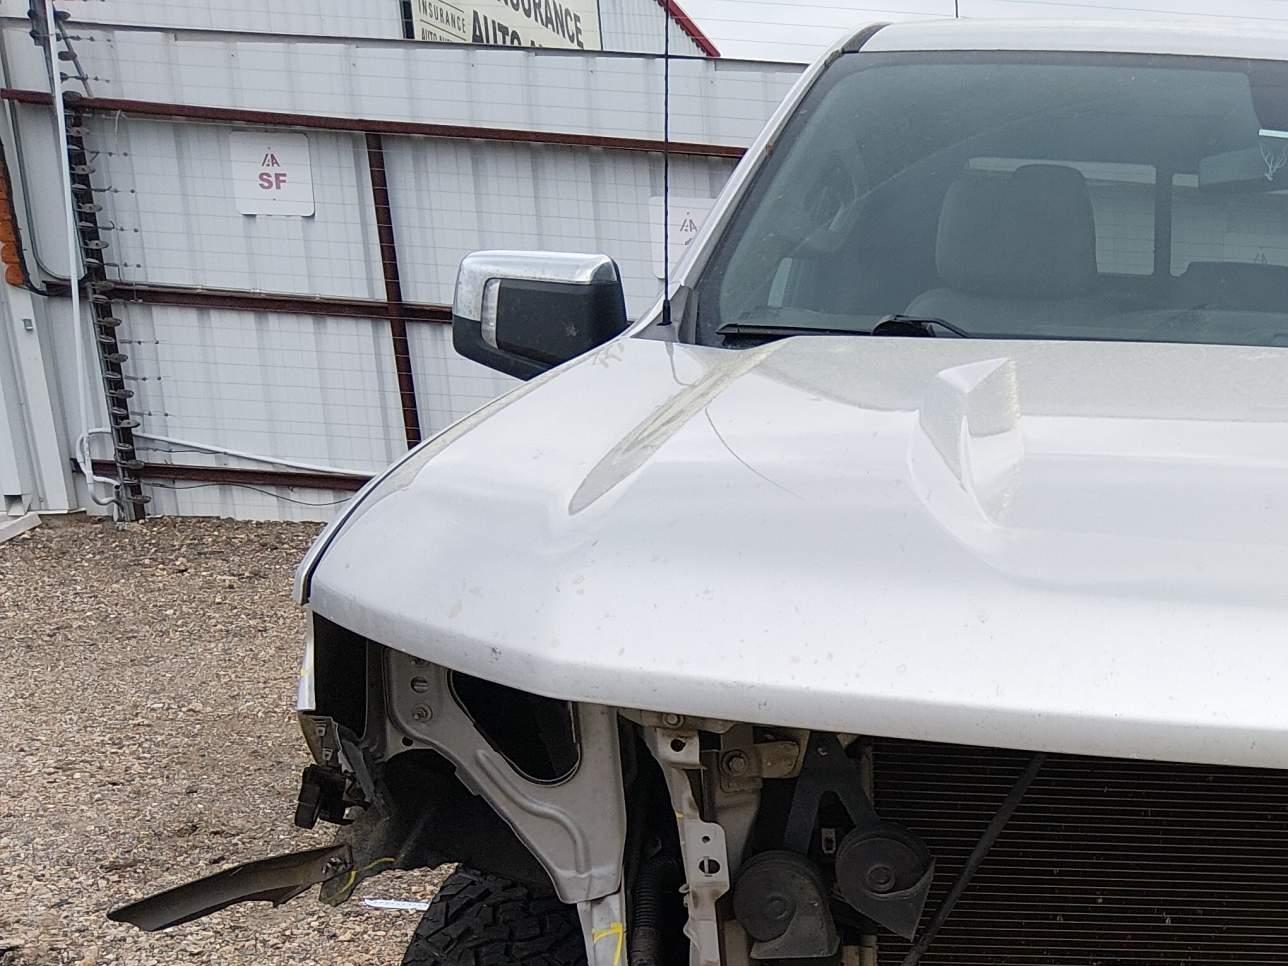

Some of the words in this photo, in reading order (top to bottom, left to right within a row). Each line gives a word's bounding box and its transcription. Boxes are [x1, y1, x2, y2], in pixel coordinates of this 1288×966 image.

[418, 0, 466, 33] INSURANCE
[497, 0, 584, 49] URANCE
[258, 172, 287, 190] SF
